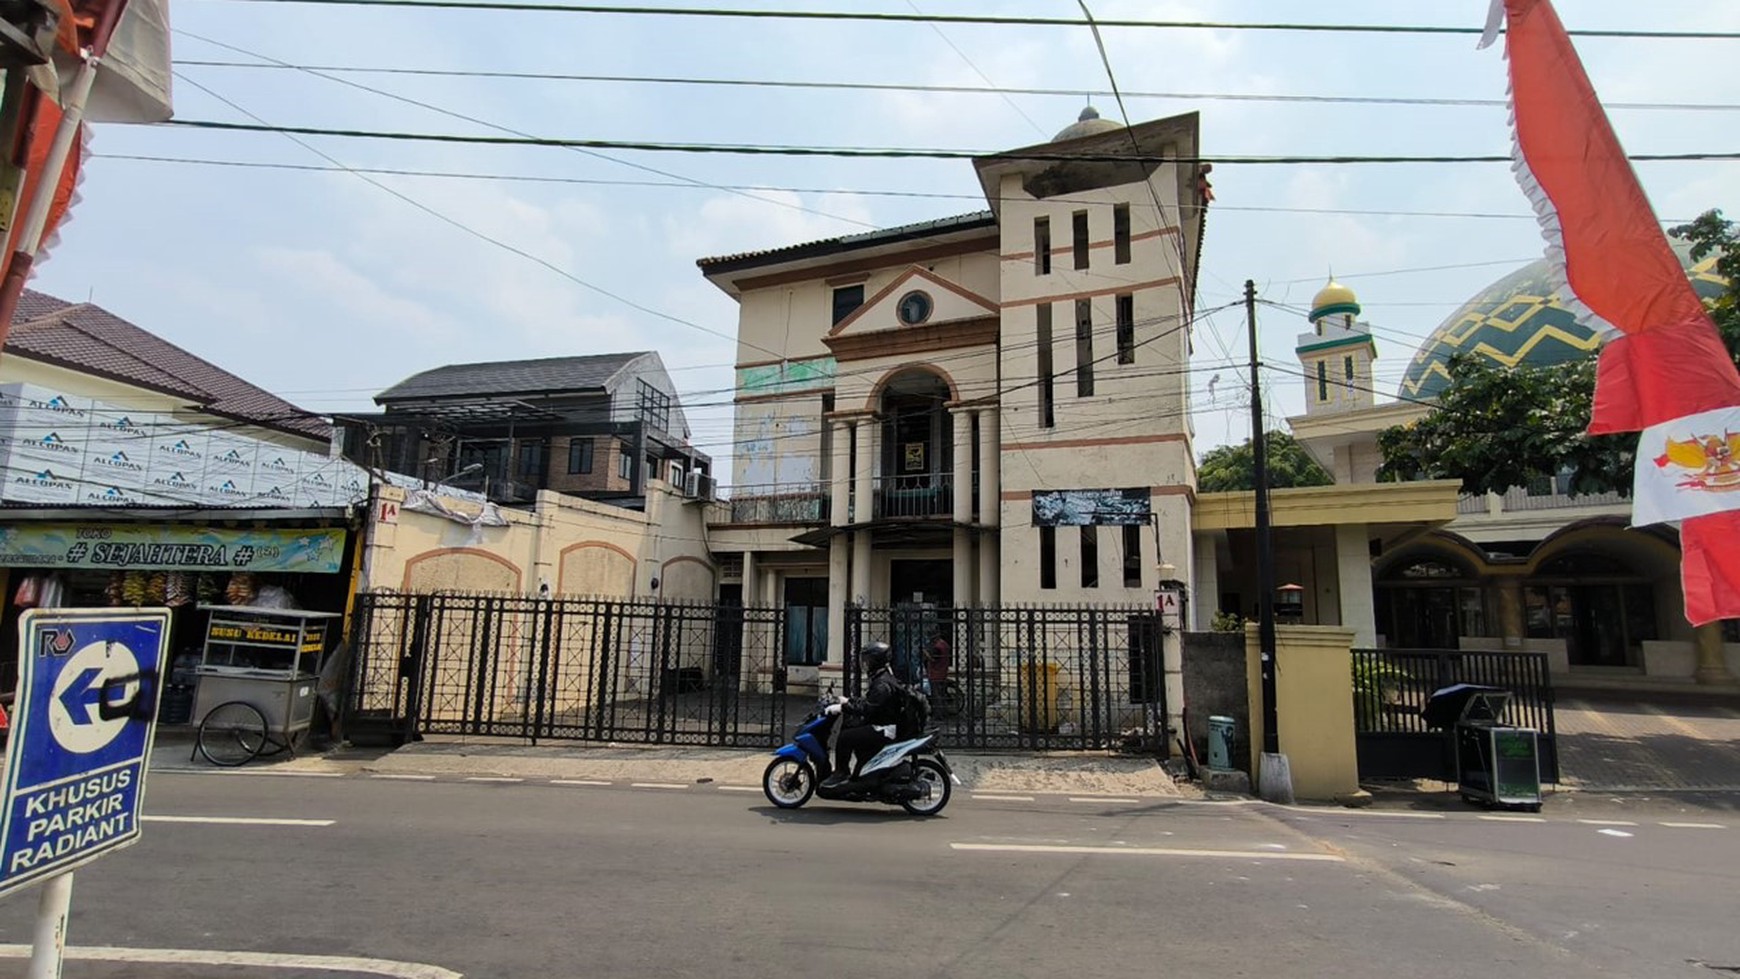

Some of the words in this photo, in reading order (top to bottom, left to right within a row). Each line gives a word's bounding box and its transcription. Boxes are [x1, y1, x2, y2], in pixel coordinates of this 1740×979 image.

[23, 438, 79, 453] ALCOPAS
[159, 444, 202, 459] ALCOPAS
[94, 456, 143, 471] ALCOPAS
[15, 476, 73, 490] ALCOPAS
[381, 502, 396, 521] 1A
[76, 527, 113, 540] TOKO
[91, 542, 229, 567] SEJAHTERA
[1157, 594, 1175, 613] 1A
[211, 626, 242, 638] SUSU
[246, 629, 297, 643] KEDELAI
[25, 769, 131, 818] KHUSUS
[27, 792, 123, 842] PARKIR
[10, 811, 129, 873] RADIANT
